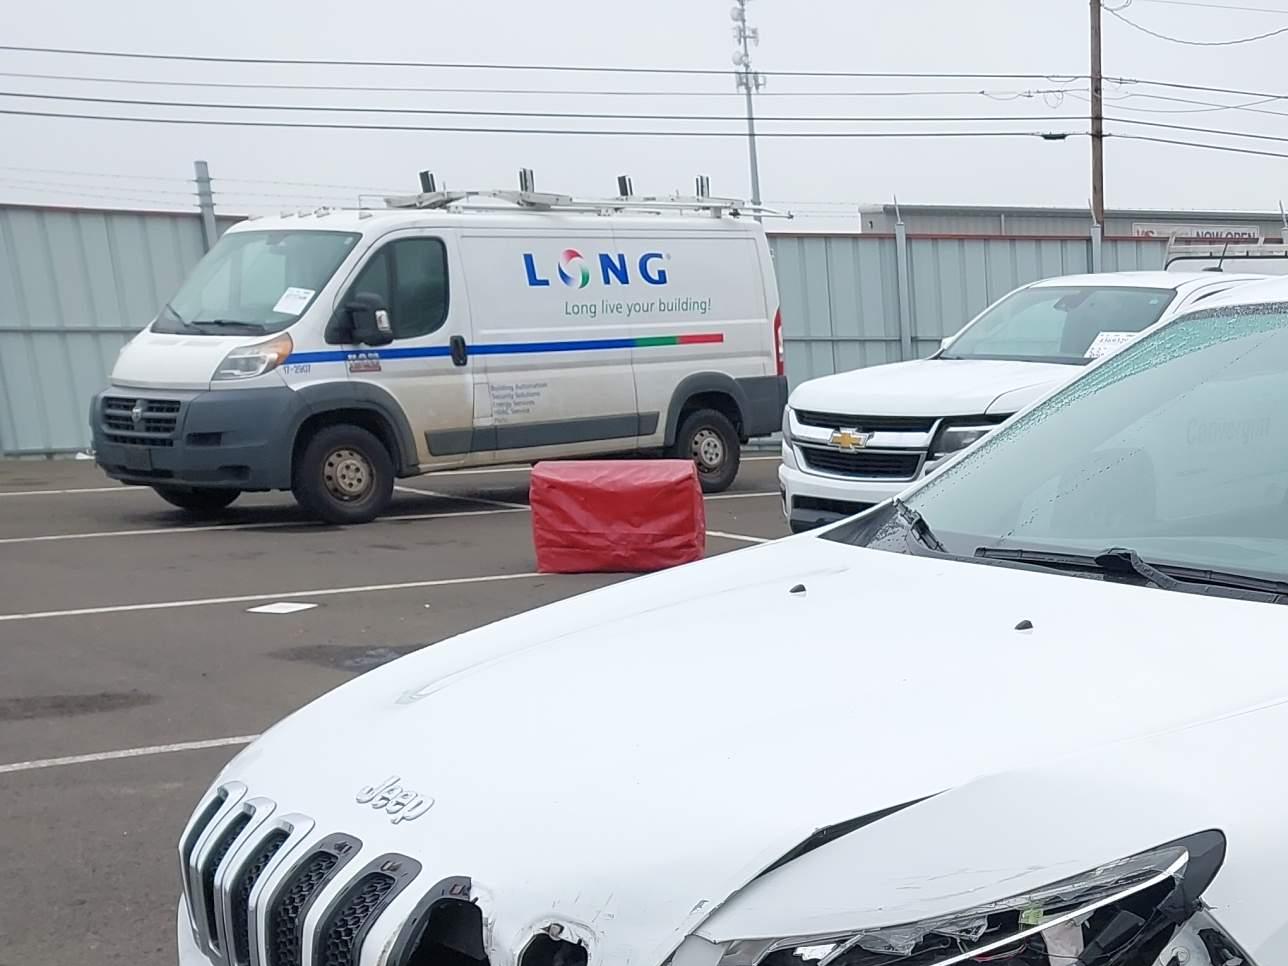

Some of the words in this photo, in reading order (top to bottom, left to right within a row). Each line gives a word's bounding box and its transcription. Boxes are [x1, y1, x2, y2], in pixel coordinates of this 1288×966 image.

[523, 249, 668, 289] LONG
[564, 301, 597, 319] Long
[601, 299, 624, 315] live
[625, 300, 656, 317] your
[658, 298, 712, 315] building!
[355, 775, 435, 825] Jeep
